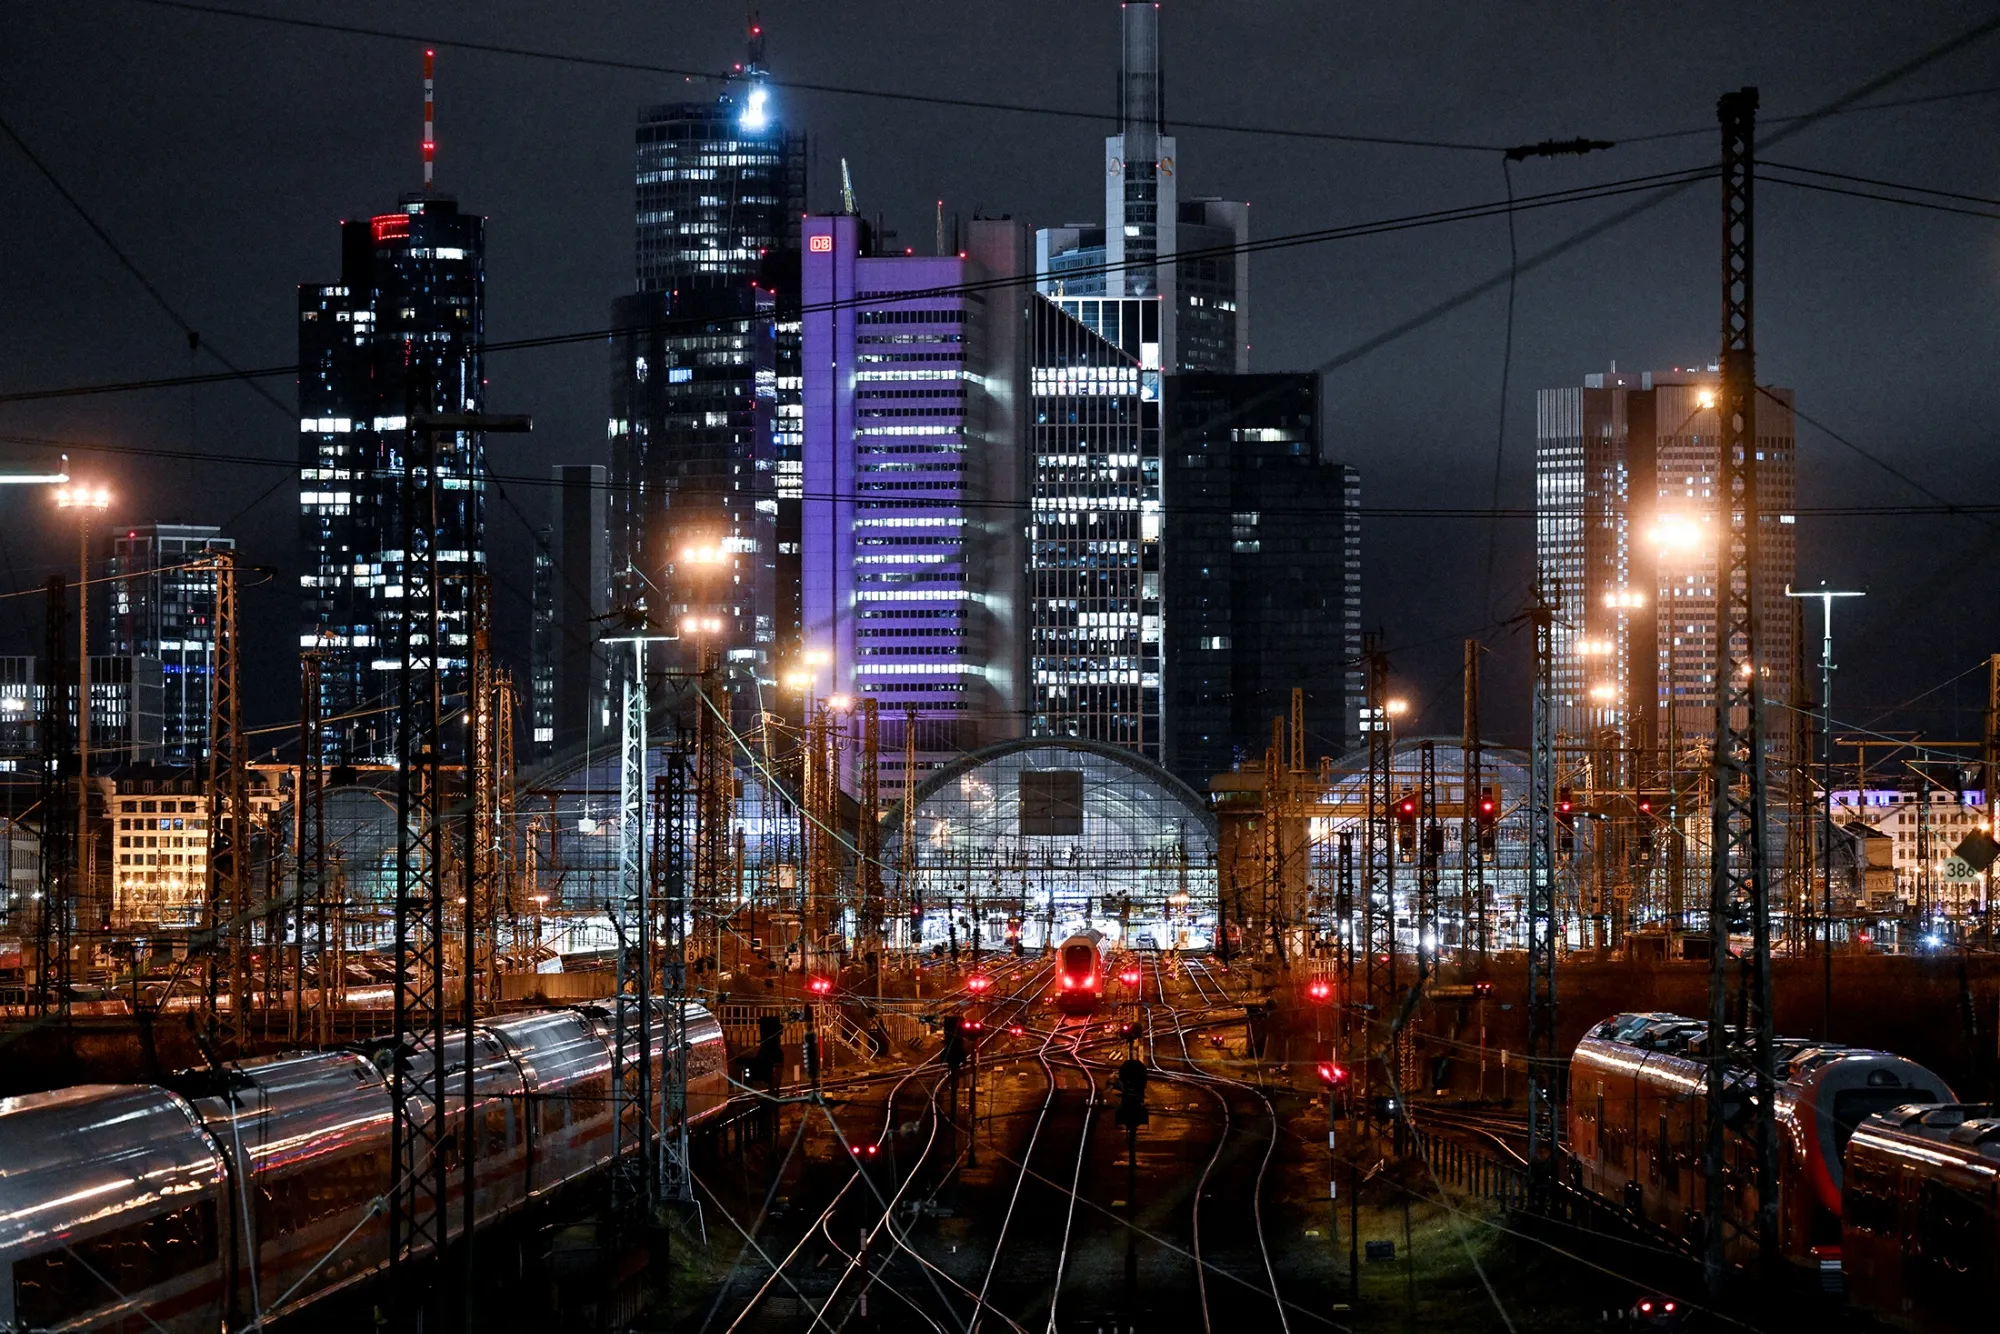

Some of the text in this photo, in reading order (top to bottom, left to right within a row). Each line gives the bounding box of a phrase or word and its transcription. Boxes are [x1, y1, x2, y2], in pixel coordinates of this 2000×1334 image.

[812, 238, 830, 250] DB
[1946, 862, 1976, 878] 386
[1615, 887, 1630, 896] 382
